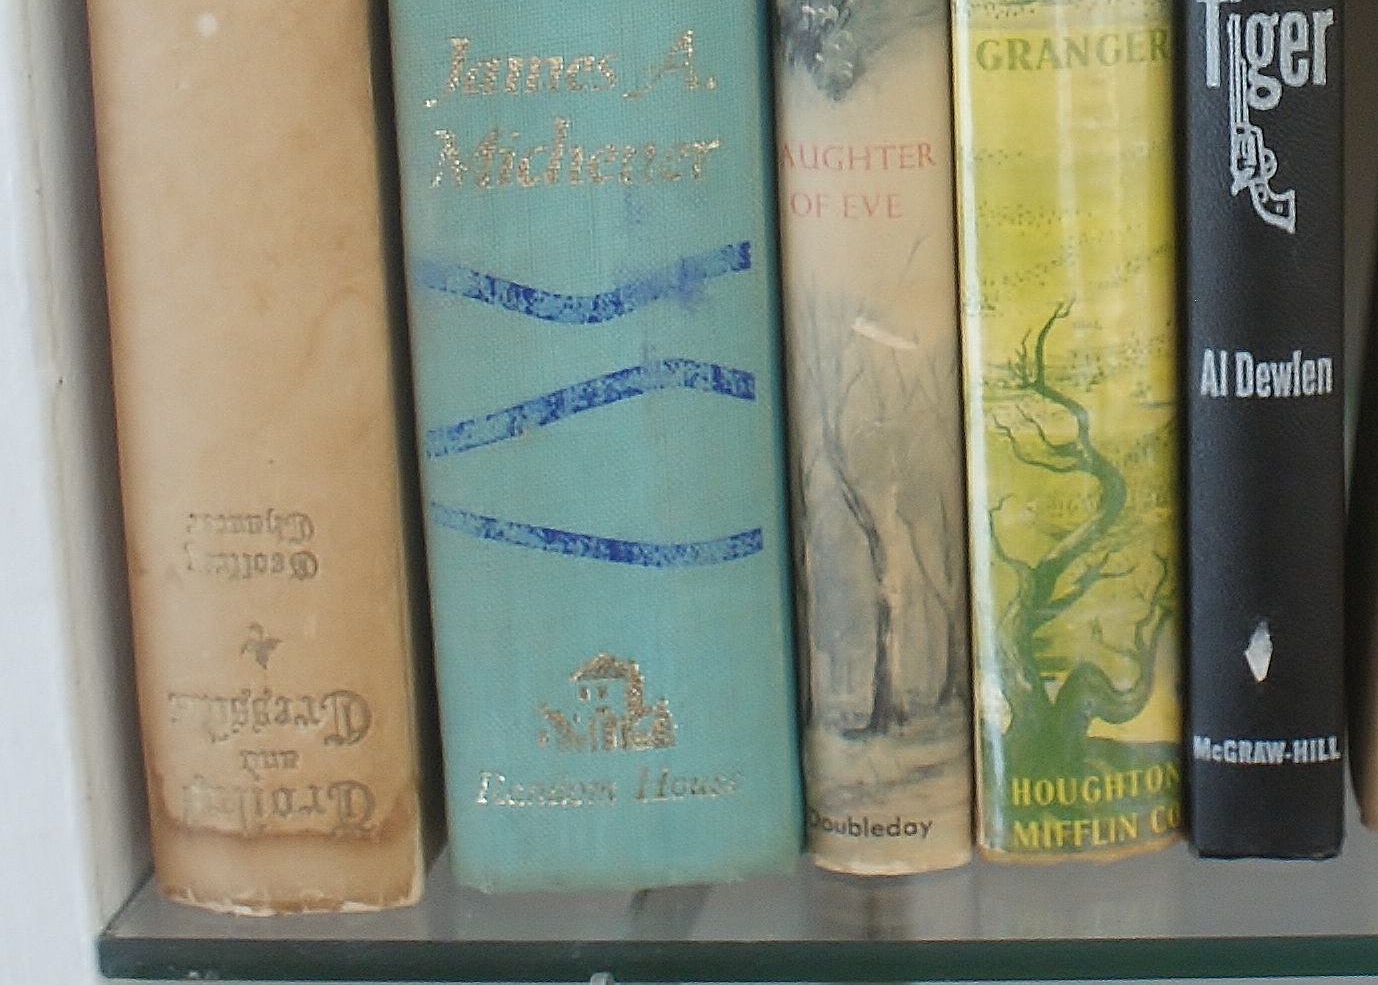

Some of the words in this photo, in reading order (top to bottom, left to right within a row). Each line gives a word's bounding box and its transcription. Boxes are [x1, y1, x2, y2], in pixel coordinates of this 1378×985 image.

[422, 36, 620, 108] James
[621, 28, 718, 101] A.
[976, 28, 1169, 71] GRANGER
[429, 116, 723, 190] Michener
[780, 142, 938, 171] AUGHTER
[789, 191, 829, 218] OF
[842, 191, 904, 219] EVE
[1201, 348, 1229, 397] Al
[1235, 349, 1334, 398] Dewlen
[239, 748, 299, 782] and
[1193, 735, 1342, 764] McGRAW-HILL
[1011, 760, 1179, 807] HOUGHTON
[1012, 811, 1138, 850] MIFFLIN
